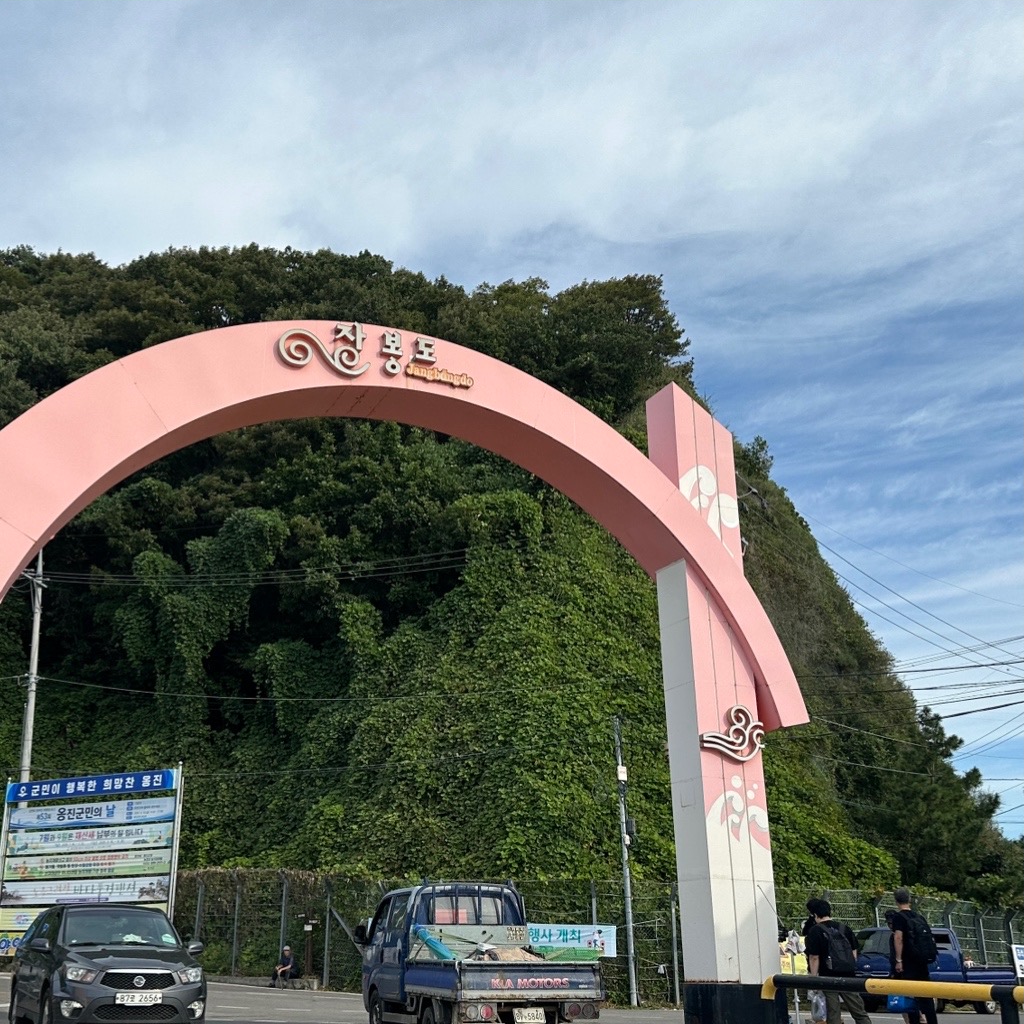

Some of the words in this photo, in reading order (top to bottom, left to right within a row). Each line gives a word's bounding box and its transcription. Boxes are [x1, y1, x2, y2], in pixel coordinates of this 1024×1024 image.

[332, 321, 438, 378] 장봉도
[31, 783, 61, 797] 군민이
[66, 780, 97, 794] 행복한
[102, 777, 135, 791] 희망찬
[141, 774, 163, 788] 옹진
[57, 806, 103, 822] 옹진군민의
[105, 804, 116, 818] 날
[528, 927, 553, 943] 행사
[556, 928, 581, 943] 개최
[491, 977, 514, 989] KIA
[516, 977, 570, 989] MOTORS
[138, 994, 159, 1003] 2656
